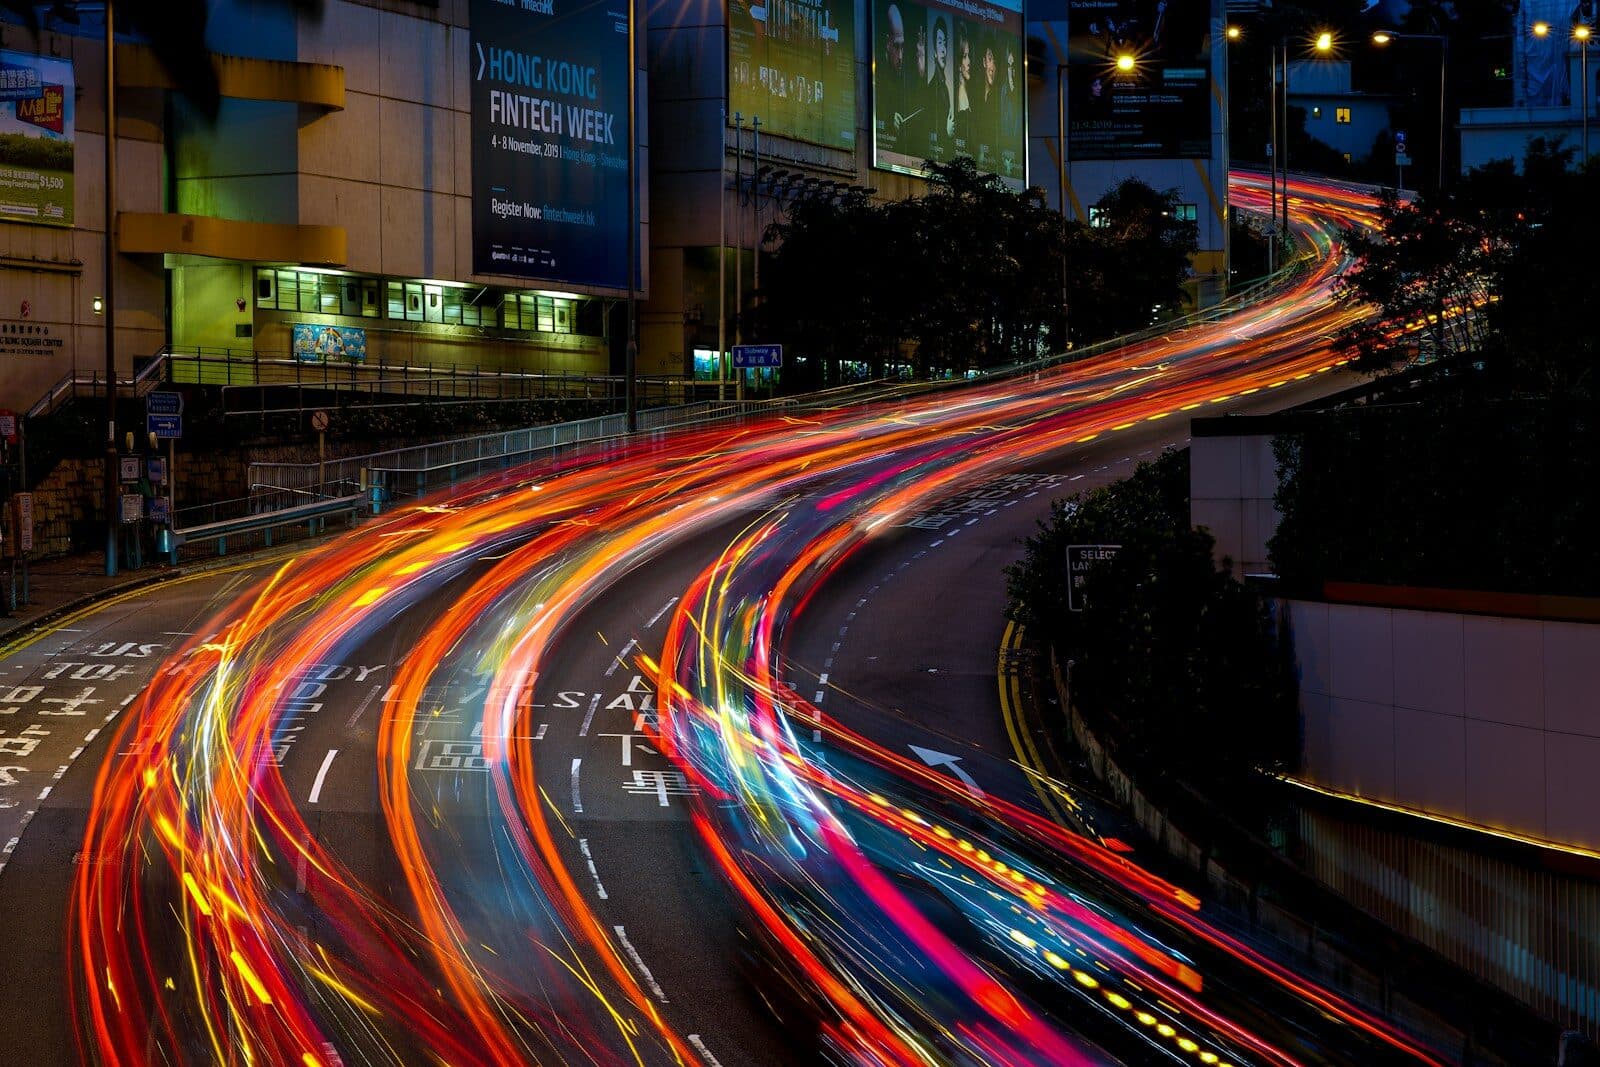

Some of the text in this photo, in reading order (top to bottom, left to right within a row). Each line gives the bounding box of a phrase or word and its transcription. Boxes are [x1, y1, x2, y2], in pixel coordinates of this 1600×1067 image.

[489, 47, 597, 101] HONG KONG
[490, 90, 615, 145] FINTECH WEEK
[491, 134, 498, 148] 4
[502, 136, 508, 150] 8
[508, 137, 542, 159] November,
[543, 143, 559, 158] 2019
[40, 176, 64, 190] $1,500
[491, 198, 596, 227] Register Now: fintechweek.hk
[1072, 561, 1090, 571] LAN
[1080, 550, 1116, 560] SELECT
